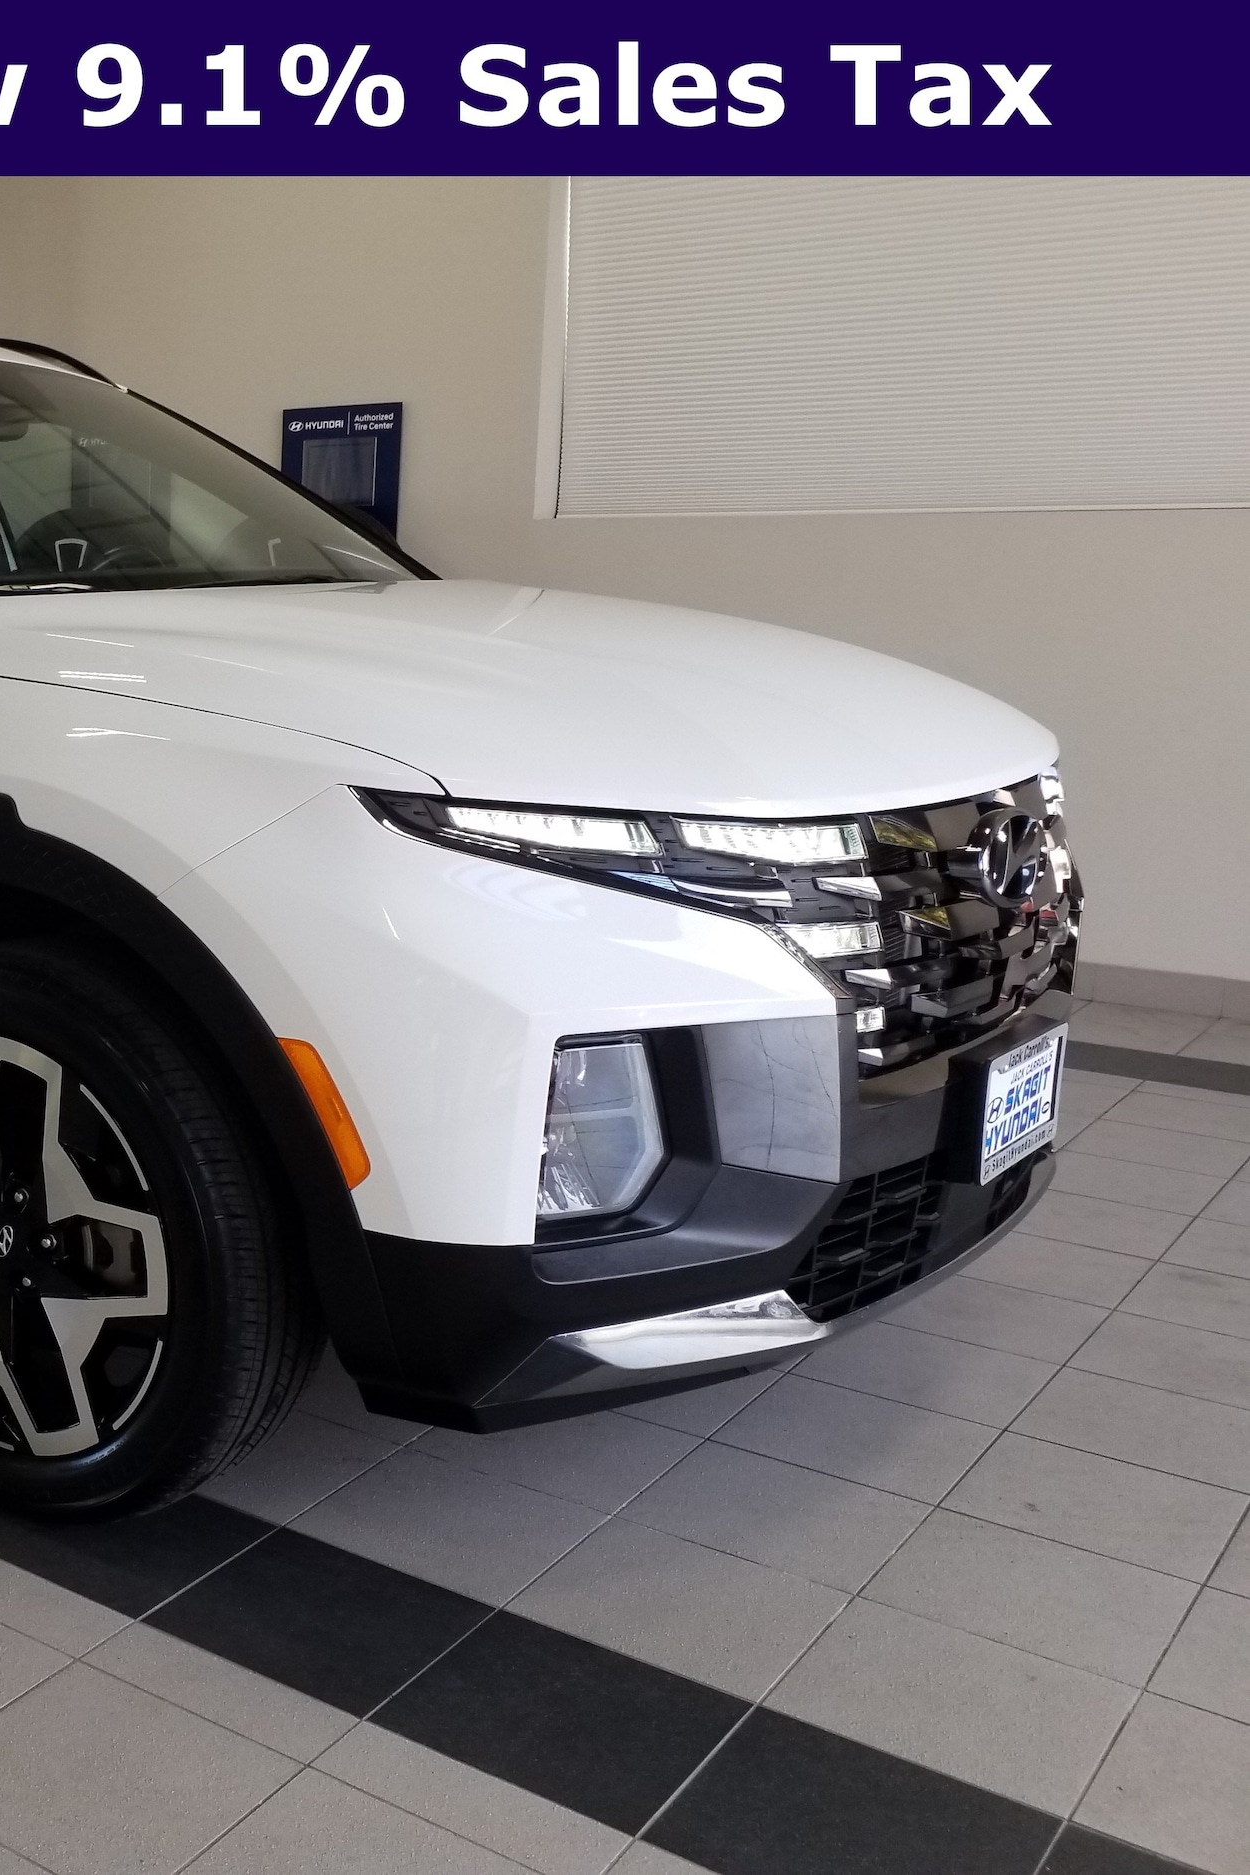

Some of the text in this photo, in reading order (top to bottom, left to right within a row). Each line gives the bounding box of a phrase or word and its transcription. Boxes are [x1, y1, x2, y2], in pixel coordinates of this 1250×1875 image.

[305, 420, 344, 430] HYUNDAI
[354, 412, 394, 422] Authorized
[354, 422, 394, 431] Tire Center
[1008, 1034, 1051, 1067] Jack Carroll's
[1010, 1066, 1025, 1085] JACK
[1004, 1065, 1051, 1115] SKAGIT
[985, 1096, 1043, 1156] HYUNDAI
[991, 1129, 1047, 1172] SkagitHyundai.com
